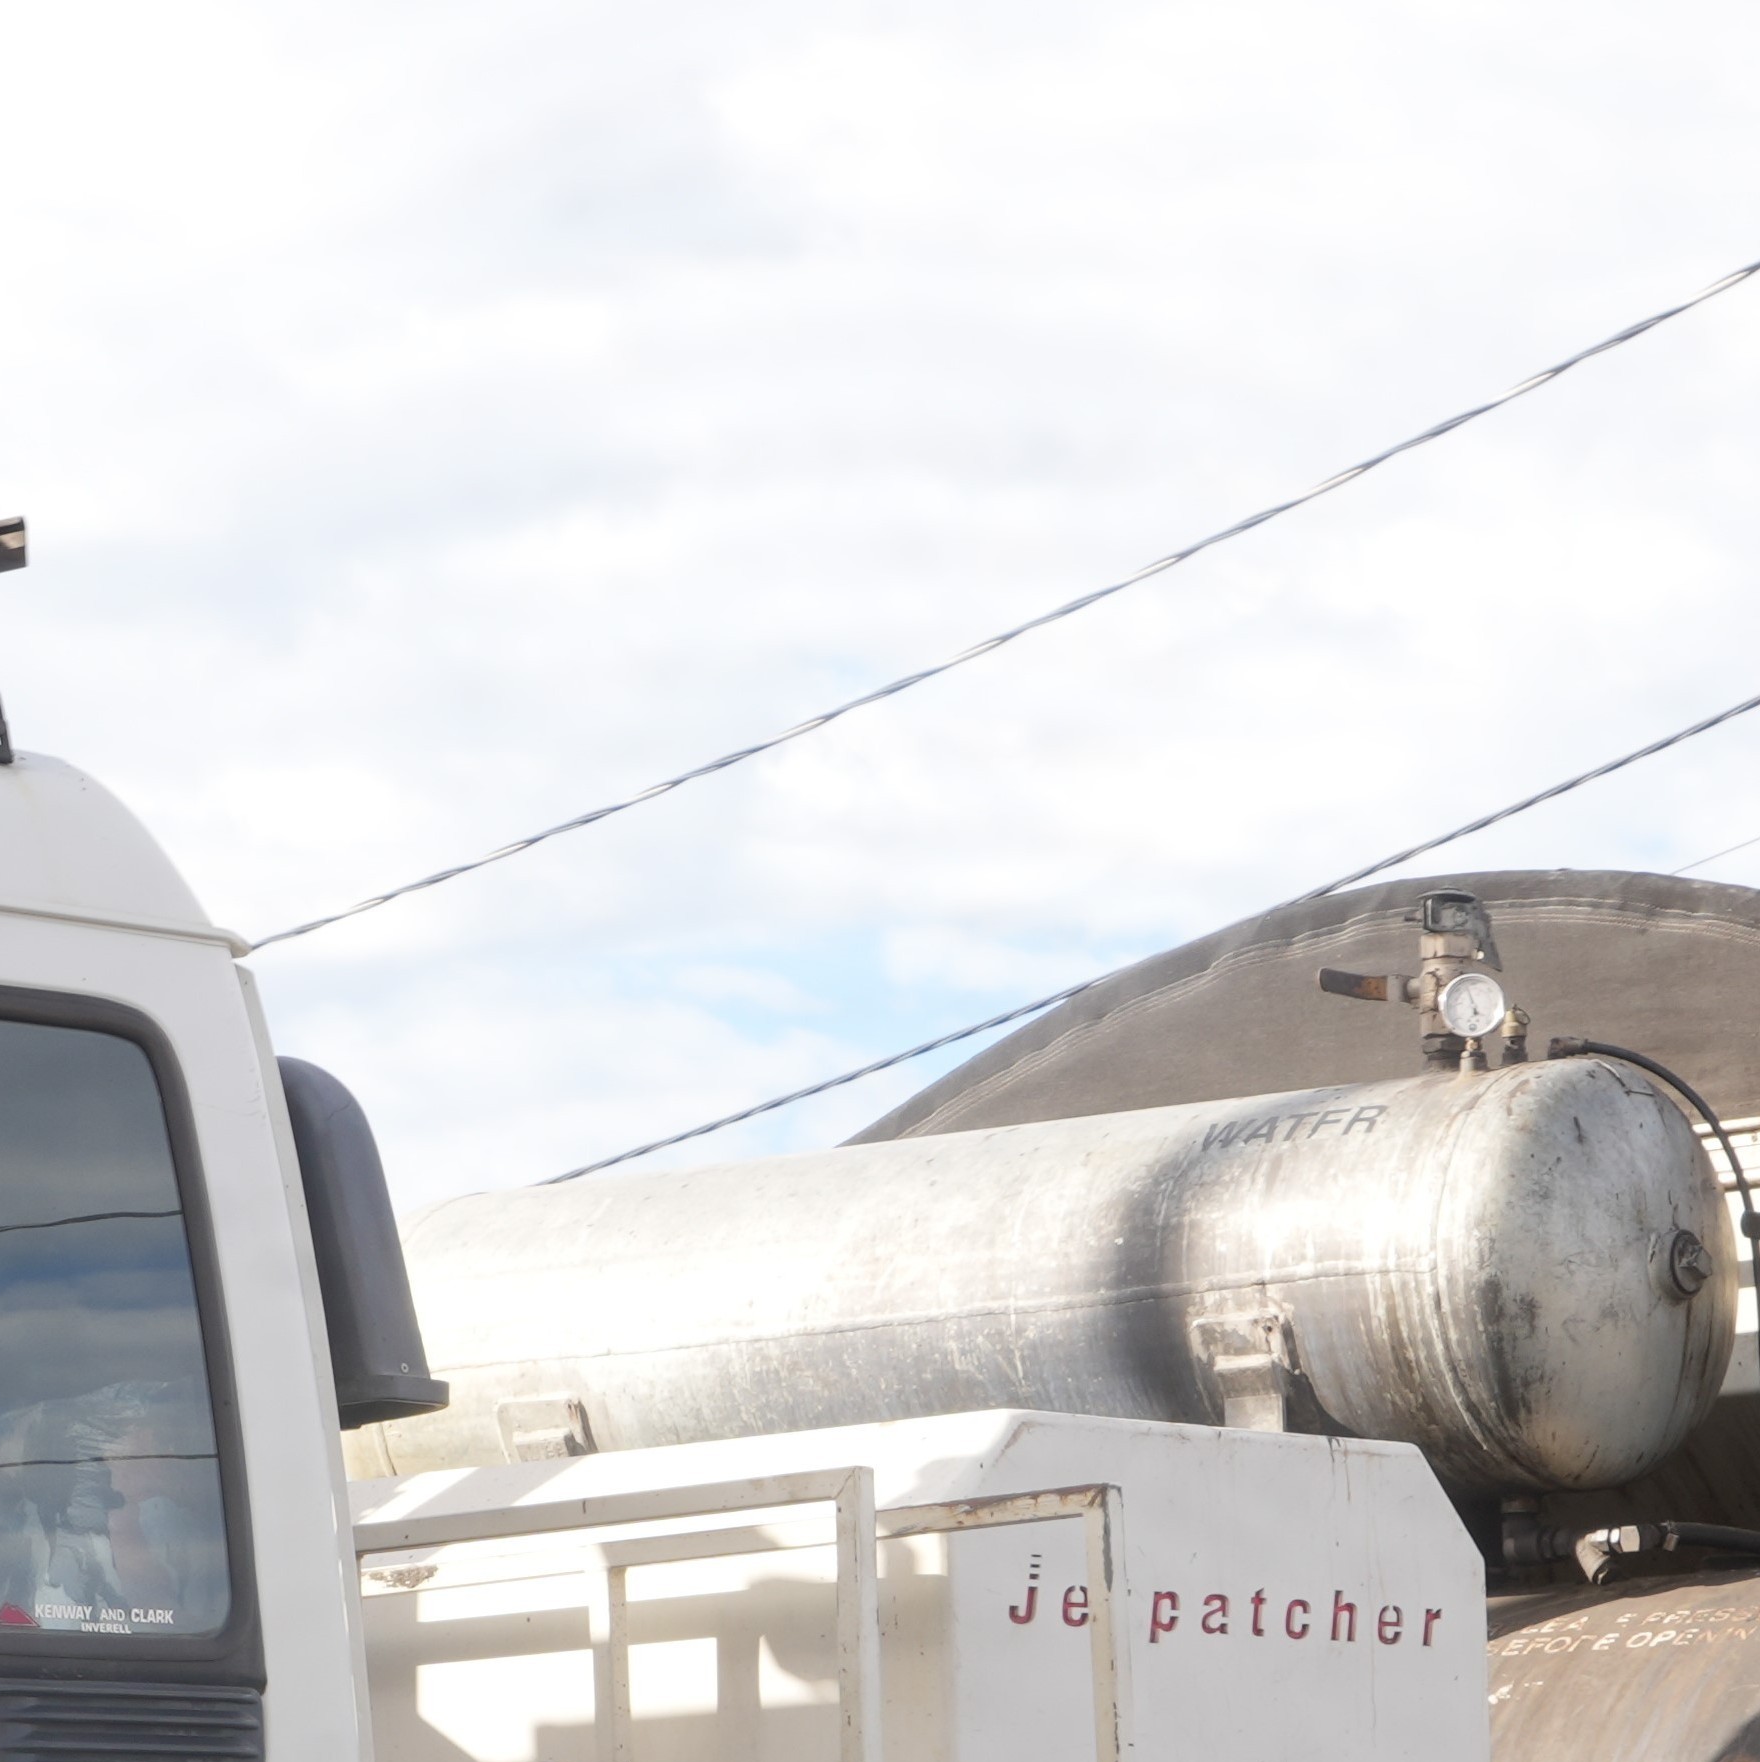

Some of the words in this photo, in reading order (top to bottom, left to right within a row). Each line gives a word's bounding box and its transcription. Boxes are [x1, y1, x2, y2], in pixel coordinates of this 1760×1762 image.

[1009, 1554, 1442, 1646] jepatcher
[35, 1604, 93, 1621] KENWAY
[100, 1608, 126, 1622] AND
[131, 1608, 174, 1624] CLARK
[81, 1622, 132, 1634] INVERELL
